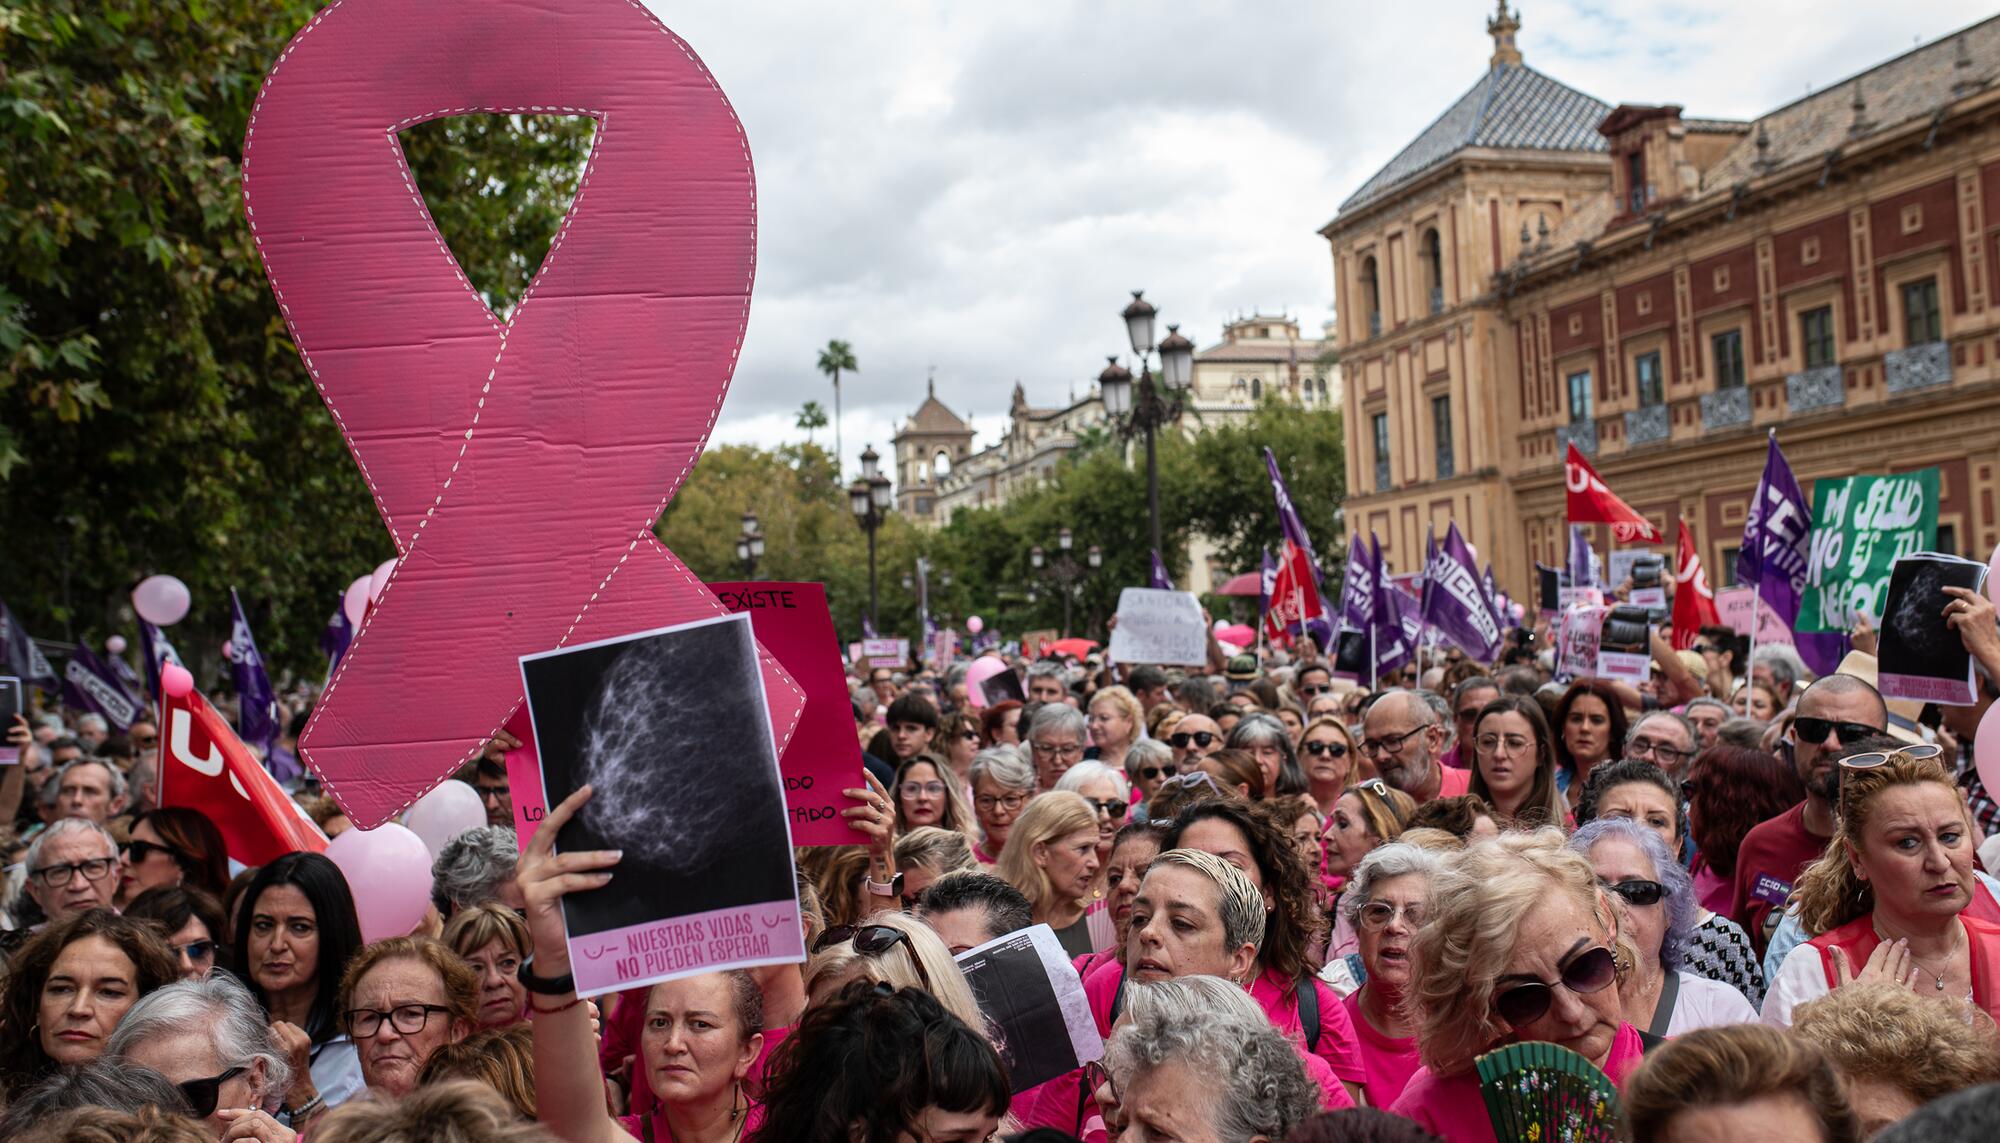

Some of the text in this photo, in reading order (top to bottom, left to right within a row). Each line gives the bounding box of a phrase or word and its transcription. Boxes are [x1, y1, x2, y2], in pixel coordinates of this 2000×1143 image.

[1805, 527, 1843, 588] NO
[1848, 530, 1882, 578] ES
[1818, 576, 1890, 631] NEGOC
[523, 806, 546, 822] LO
[615, 933, 770, 981] NO PUEDEN ESPERAR
[626, 912, 753, 955] NUESTRAS VIDAS
